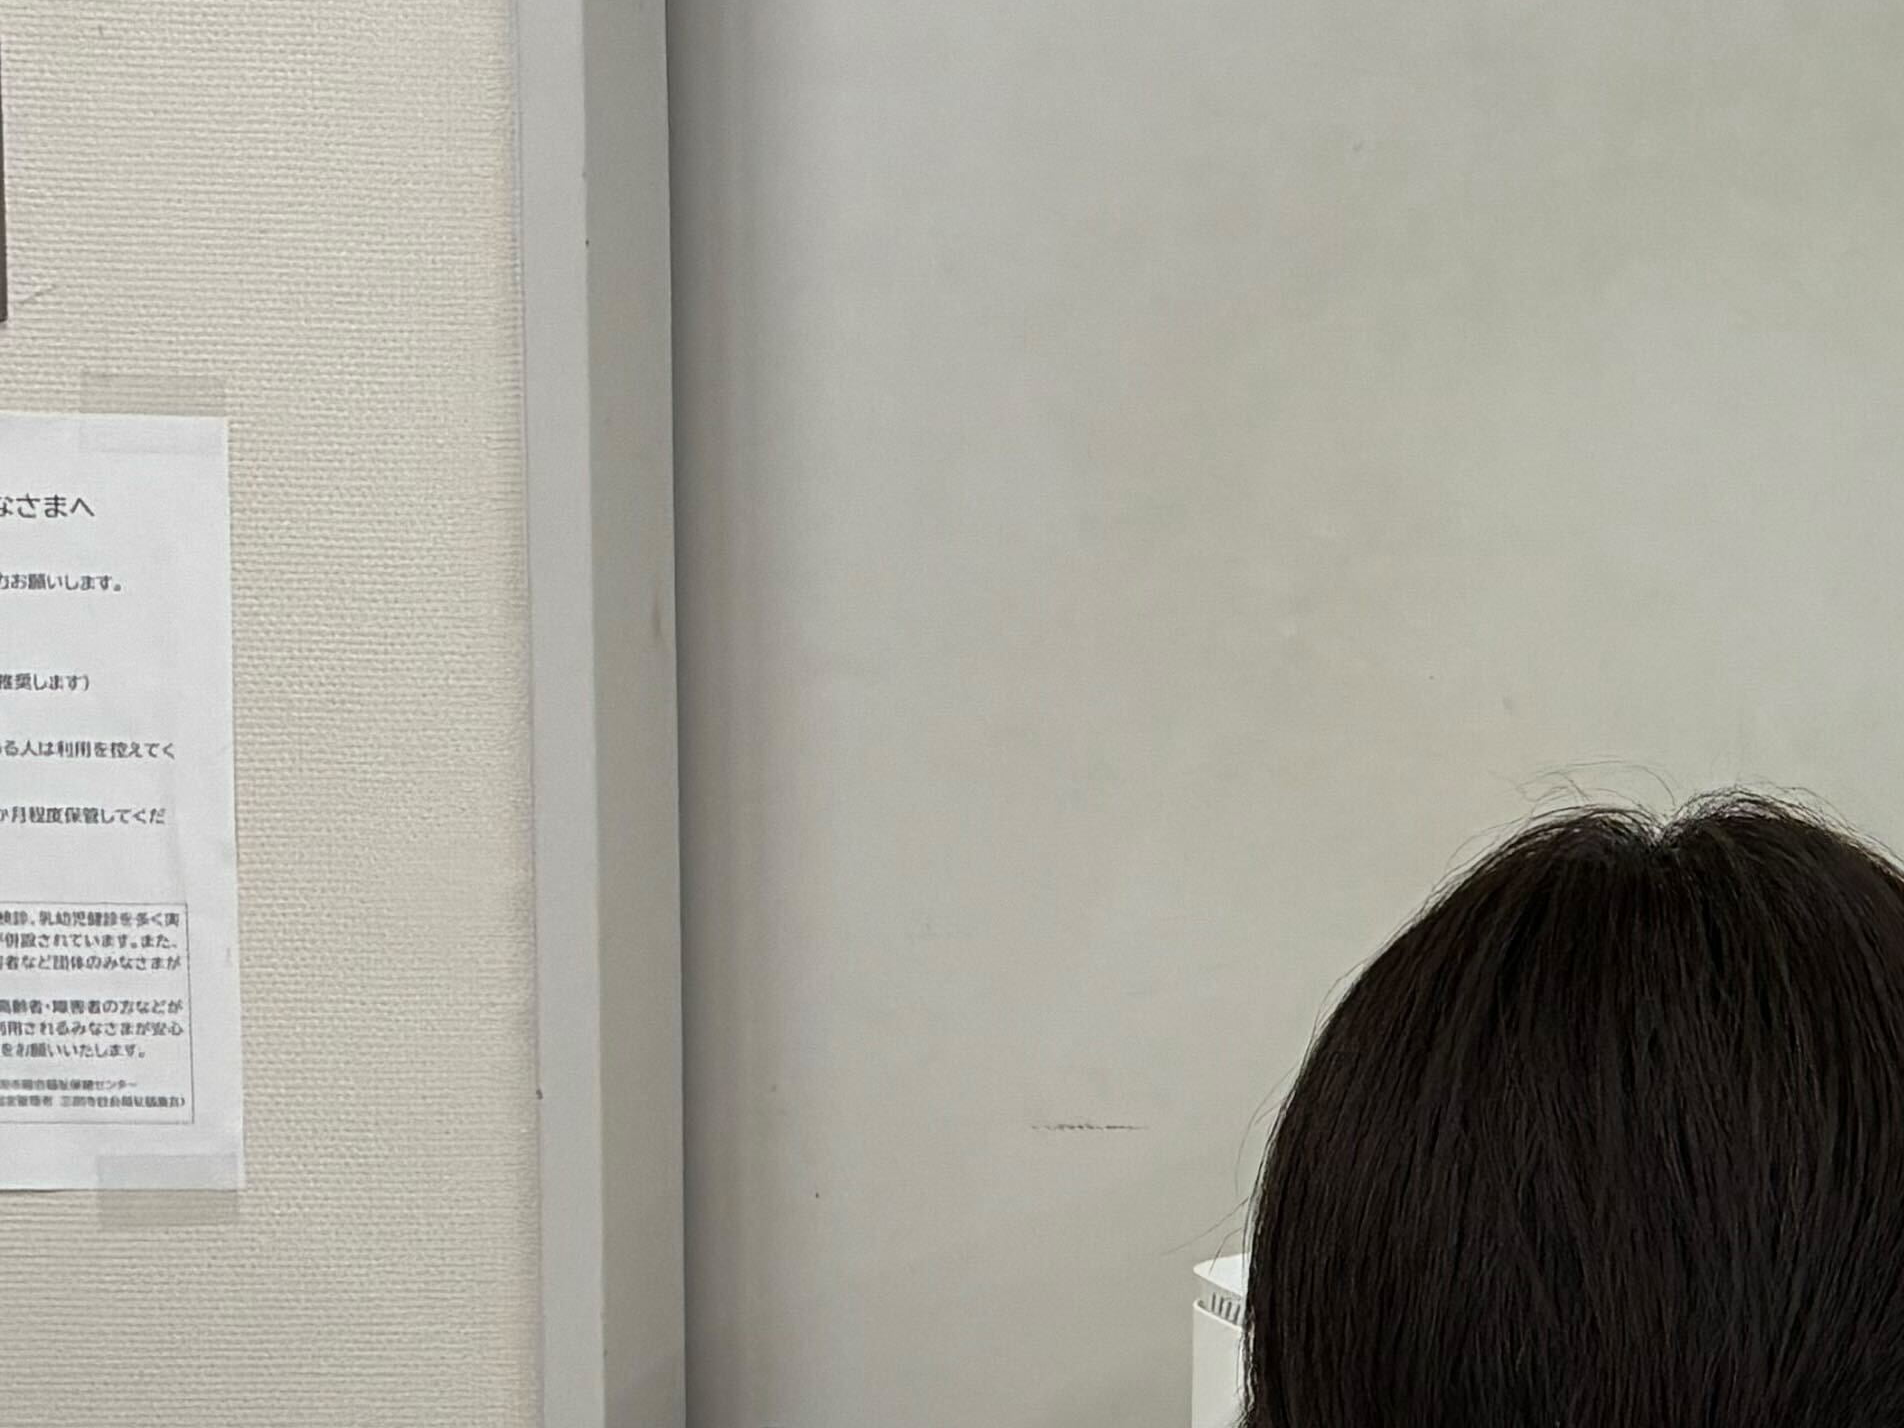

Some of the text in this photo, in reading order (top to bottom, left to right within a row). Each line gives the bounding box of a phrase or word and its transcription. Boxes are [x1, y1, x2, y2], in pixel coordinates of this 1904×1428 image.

[0, 739, 175, 760] る人は利用を控えてく
[0, 932, 178, 949] 併設されています。また、
[0, 955, 181, 971] 者など団体のみなさまが
